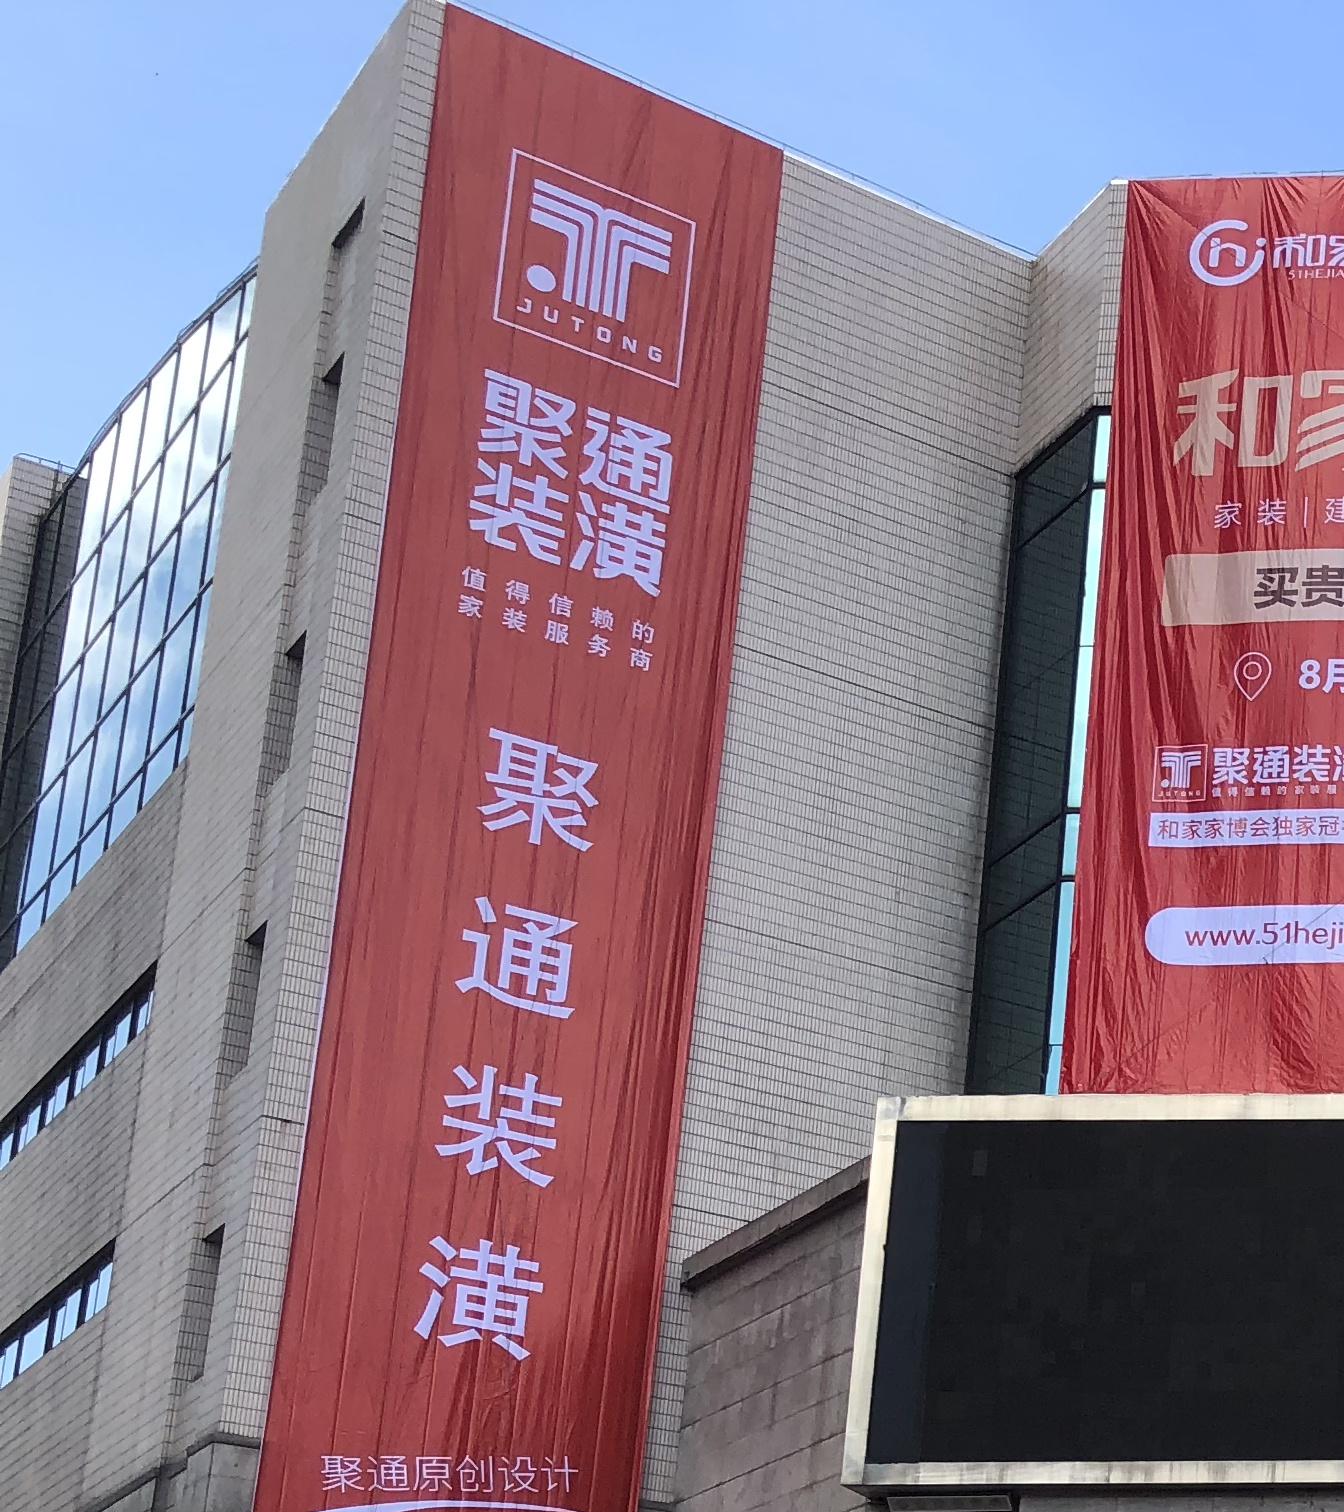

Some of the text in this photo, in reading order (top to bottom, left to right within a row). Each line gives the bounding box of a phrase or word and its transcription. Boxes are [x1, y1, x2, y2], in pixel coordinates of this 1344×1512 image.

[517, 298, 663, 362] JUTONG
[458, 595, 651, 672] 家装服务商
[461, 566, 654, 644] 值得信赖的
[414, 728, 599, 1361] 聚通装潢
[320, 1455, 578, 1494] 聚通原创设计
